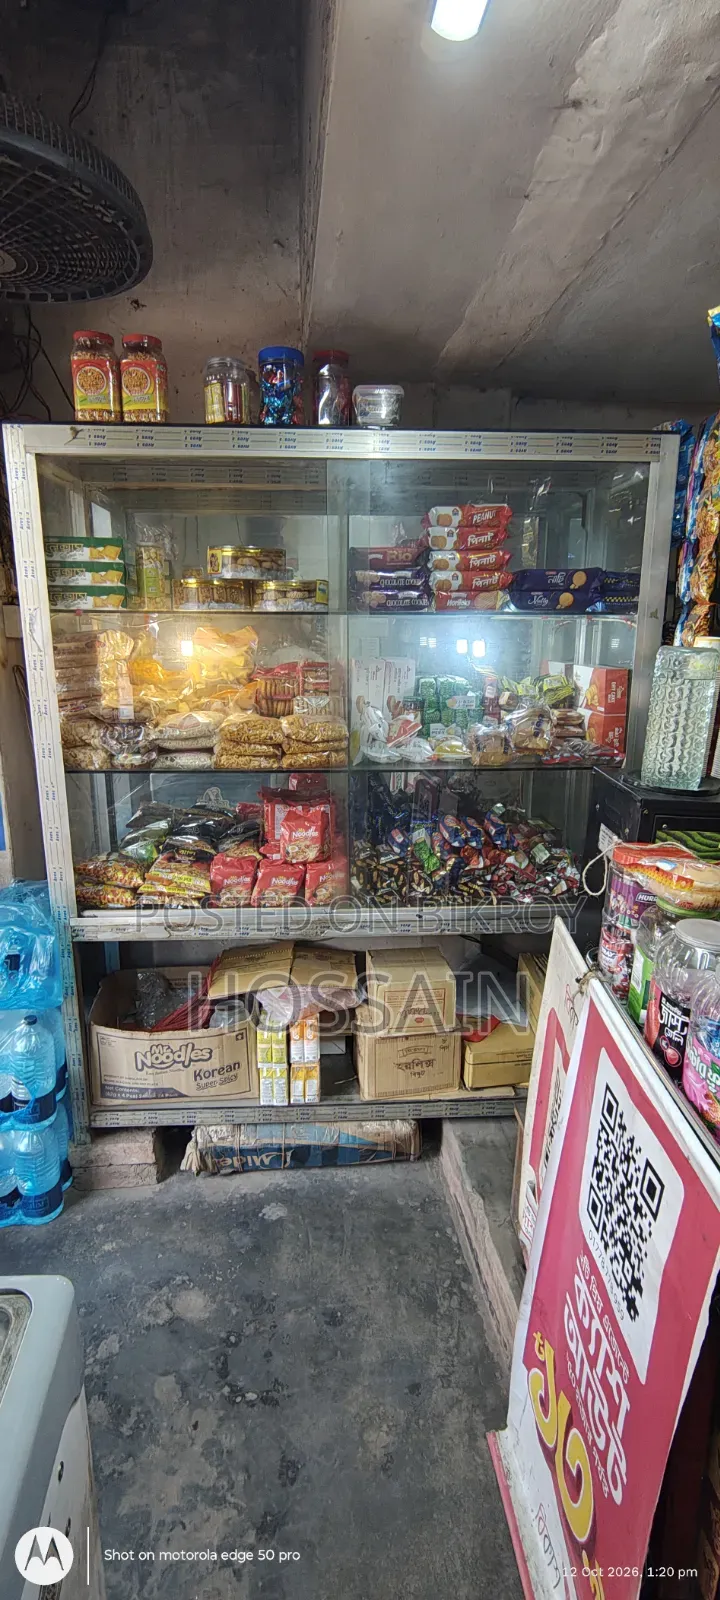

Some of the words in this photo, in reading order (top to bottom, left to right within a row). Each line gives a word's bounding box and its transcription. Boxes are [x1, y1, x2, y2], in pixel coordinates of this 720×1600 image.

[467, 532, 495, 547] পিনাট
[469, 554, 497, 569] পিনাট
[472, 576, 499, 589] পিনাট
[292, 826, 319, 839] Noodles
[134, 1042, 213, 1071] Noodles
[193, 1061, 241, 1081] Korean
[196, 1081, 217, 1091] Super
[219, 1073, 238, 1086] Spicy
[573, 1258, 632, 1438] ক্যাশ
[564, 1291, 627, 1505] আউট
